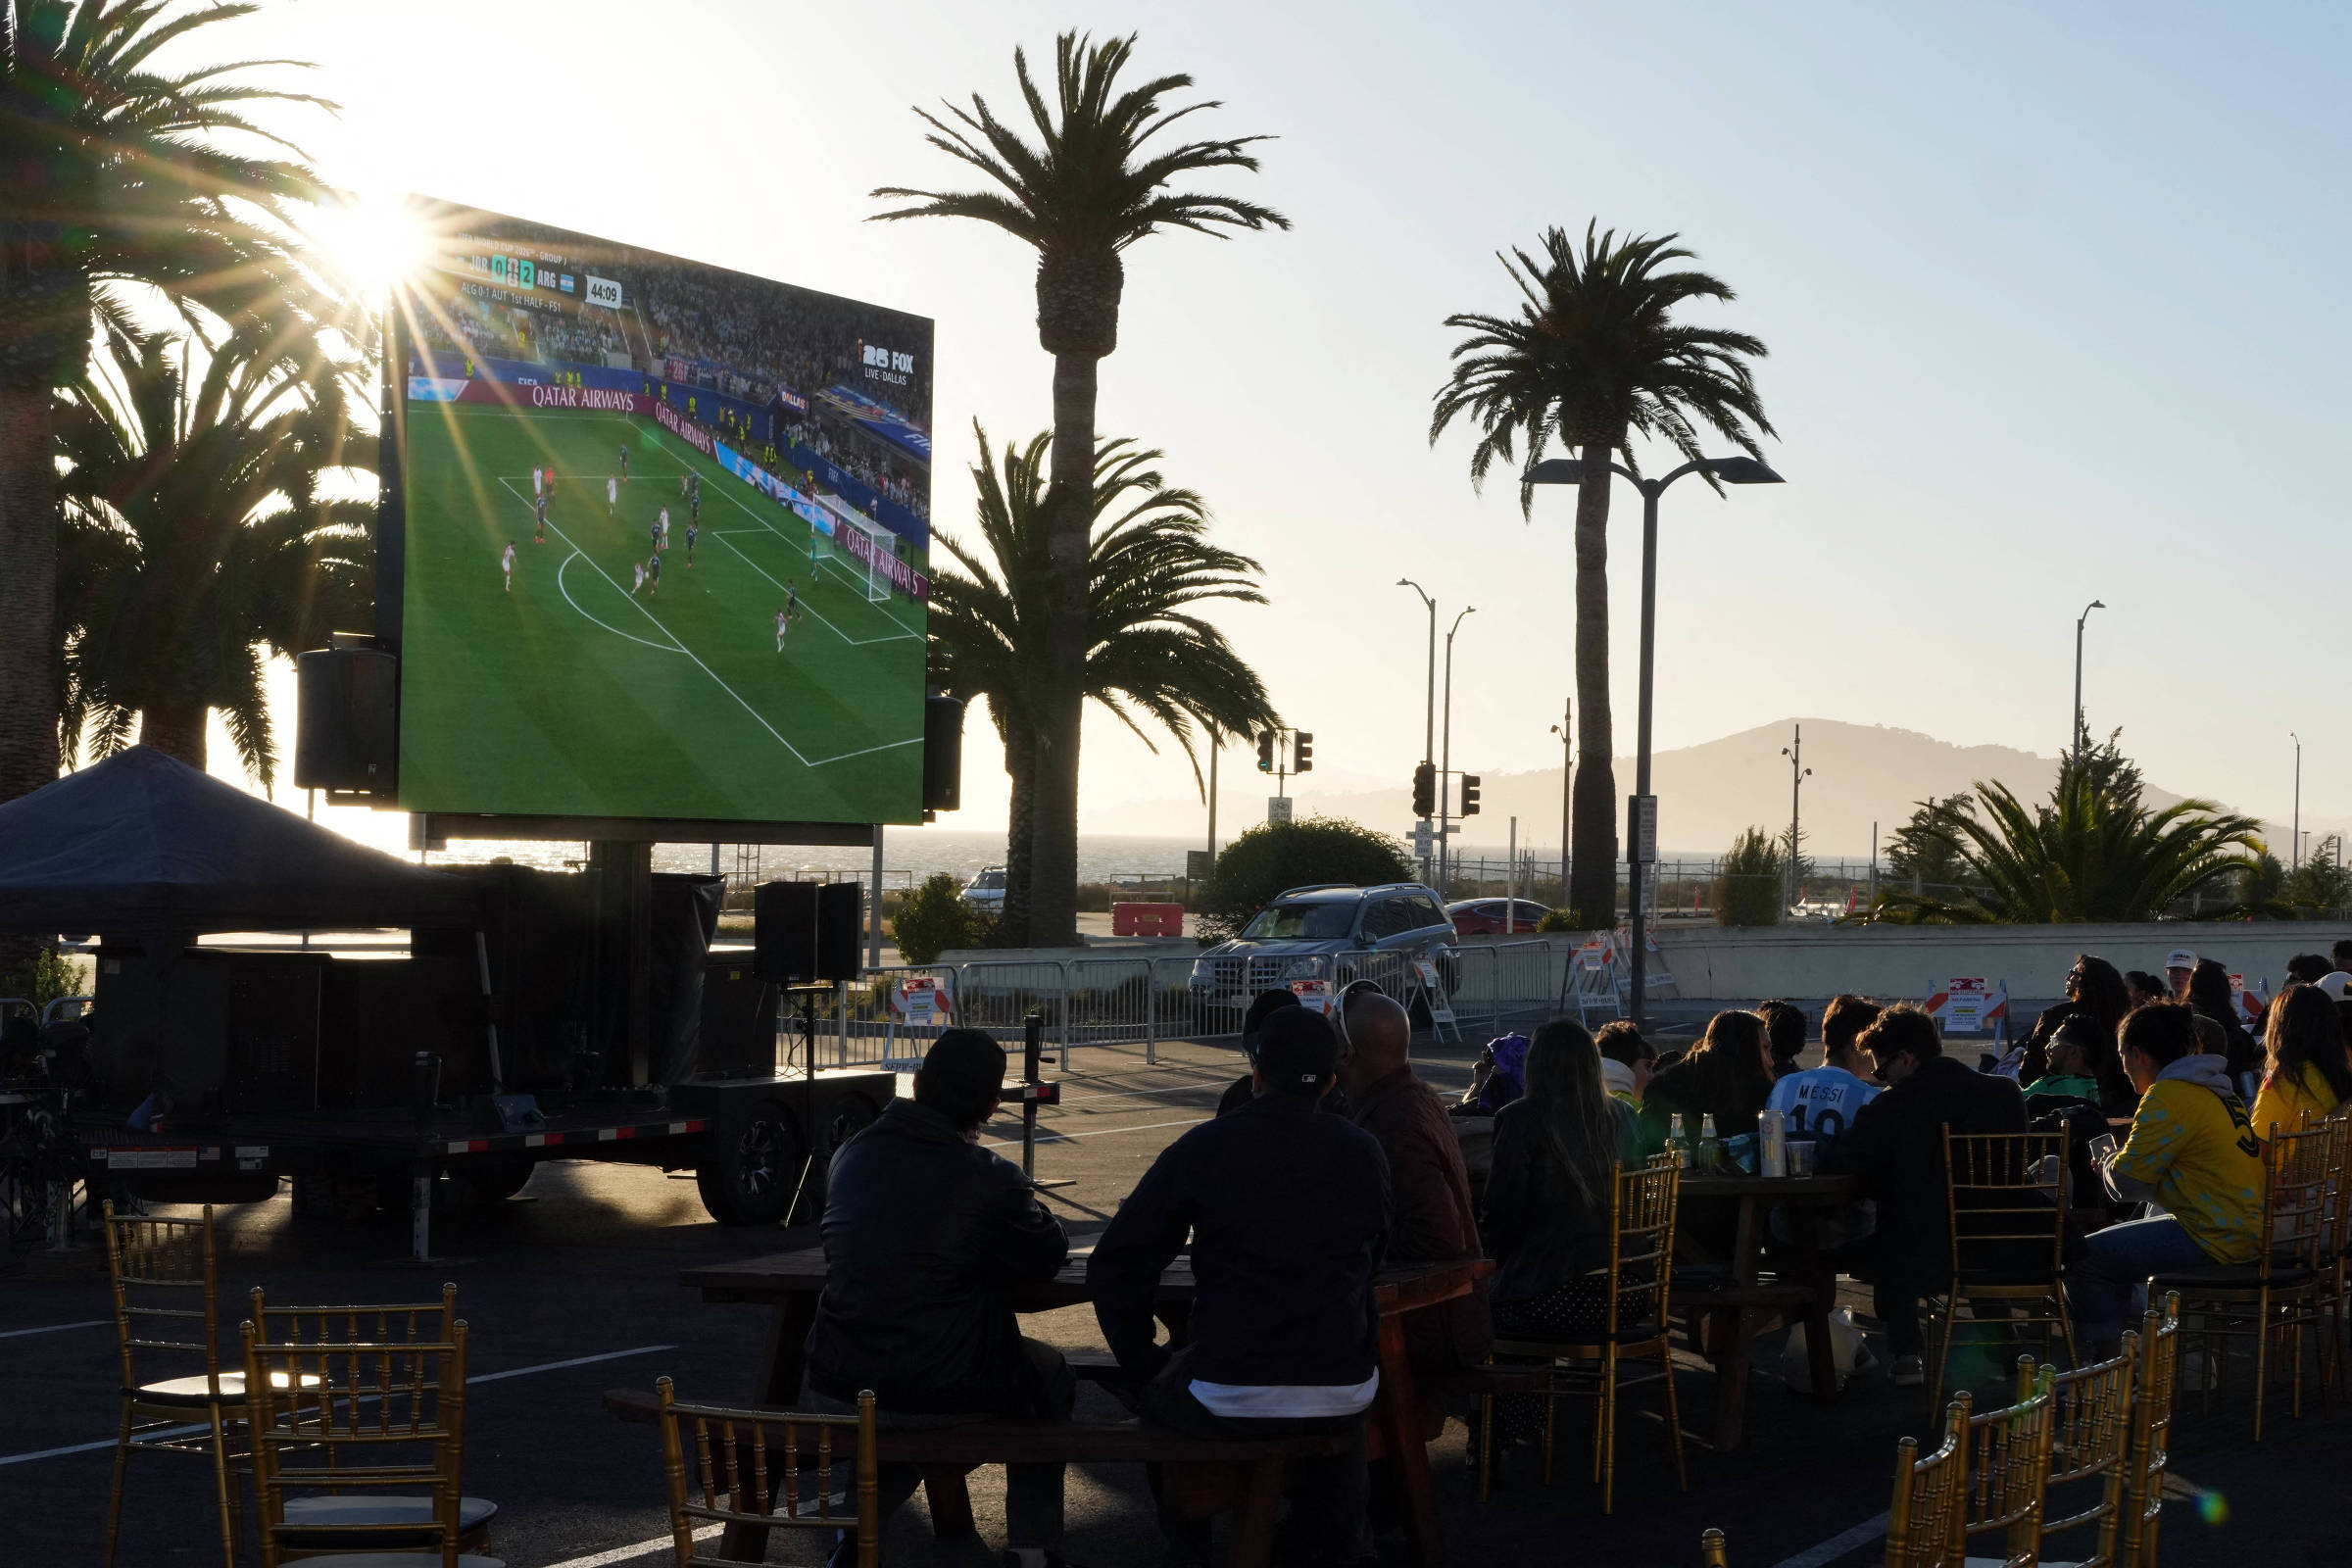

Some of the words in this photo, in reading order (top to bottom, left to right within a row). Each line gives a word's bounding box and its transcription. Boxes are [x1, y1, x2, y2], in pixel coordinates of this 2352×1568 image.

[539, 251, 563, 264] GROUP
[469, 255, 488, 274] JOR
[495, 260, 503, 277] 0
[523, 267, 531, 283] 2
[537, 269, 557, 289] ARG
[462, 282, 476, 295] ALG
[491, 288, 508, 302] AUT
[523, 295, 544, 309] HALF
[549, 300, 562, 313] FS1
[591, 282, 617, 302] 44:09
[892, 351, 914, 374] FOX
[532, 385, 576, 408] QATAR
[581, 389, 634, 412] AIRWAYS
[656, 401, 678, 434] QATAR
[680, 421, 710, 455] AIRWAYS
[1798, 1085, 1844, 1102] MESSI
[1789, 1103, 1844, 1137] 10
